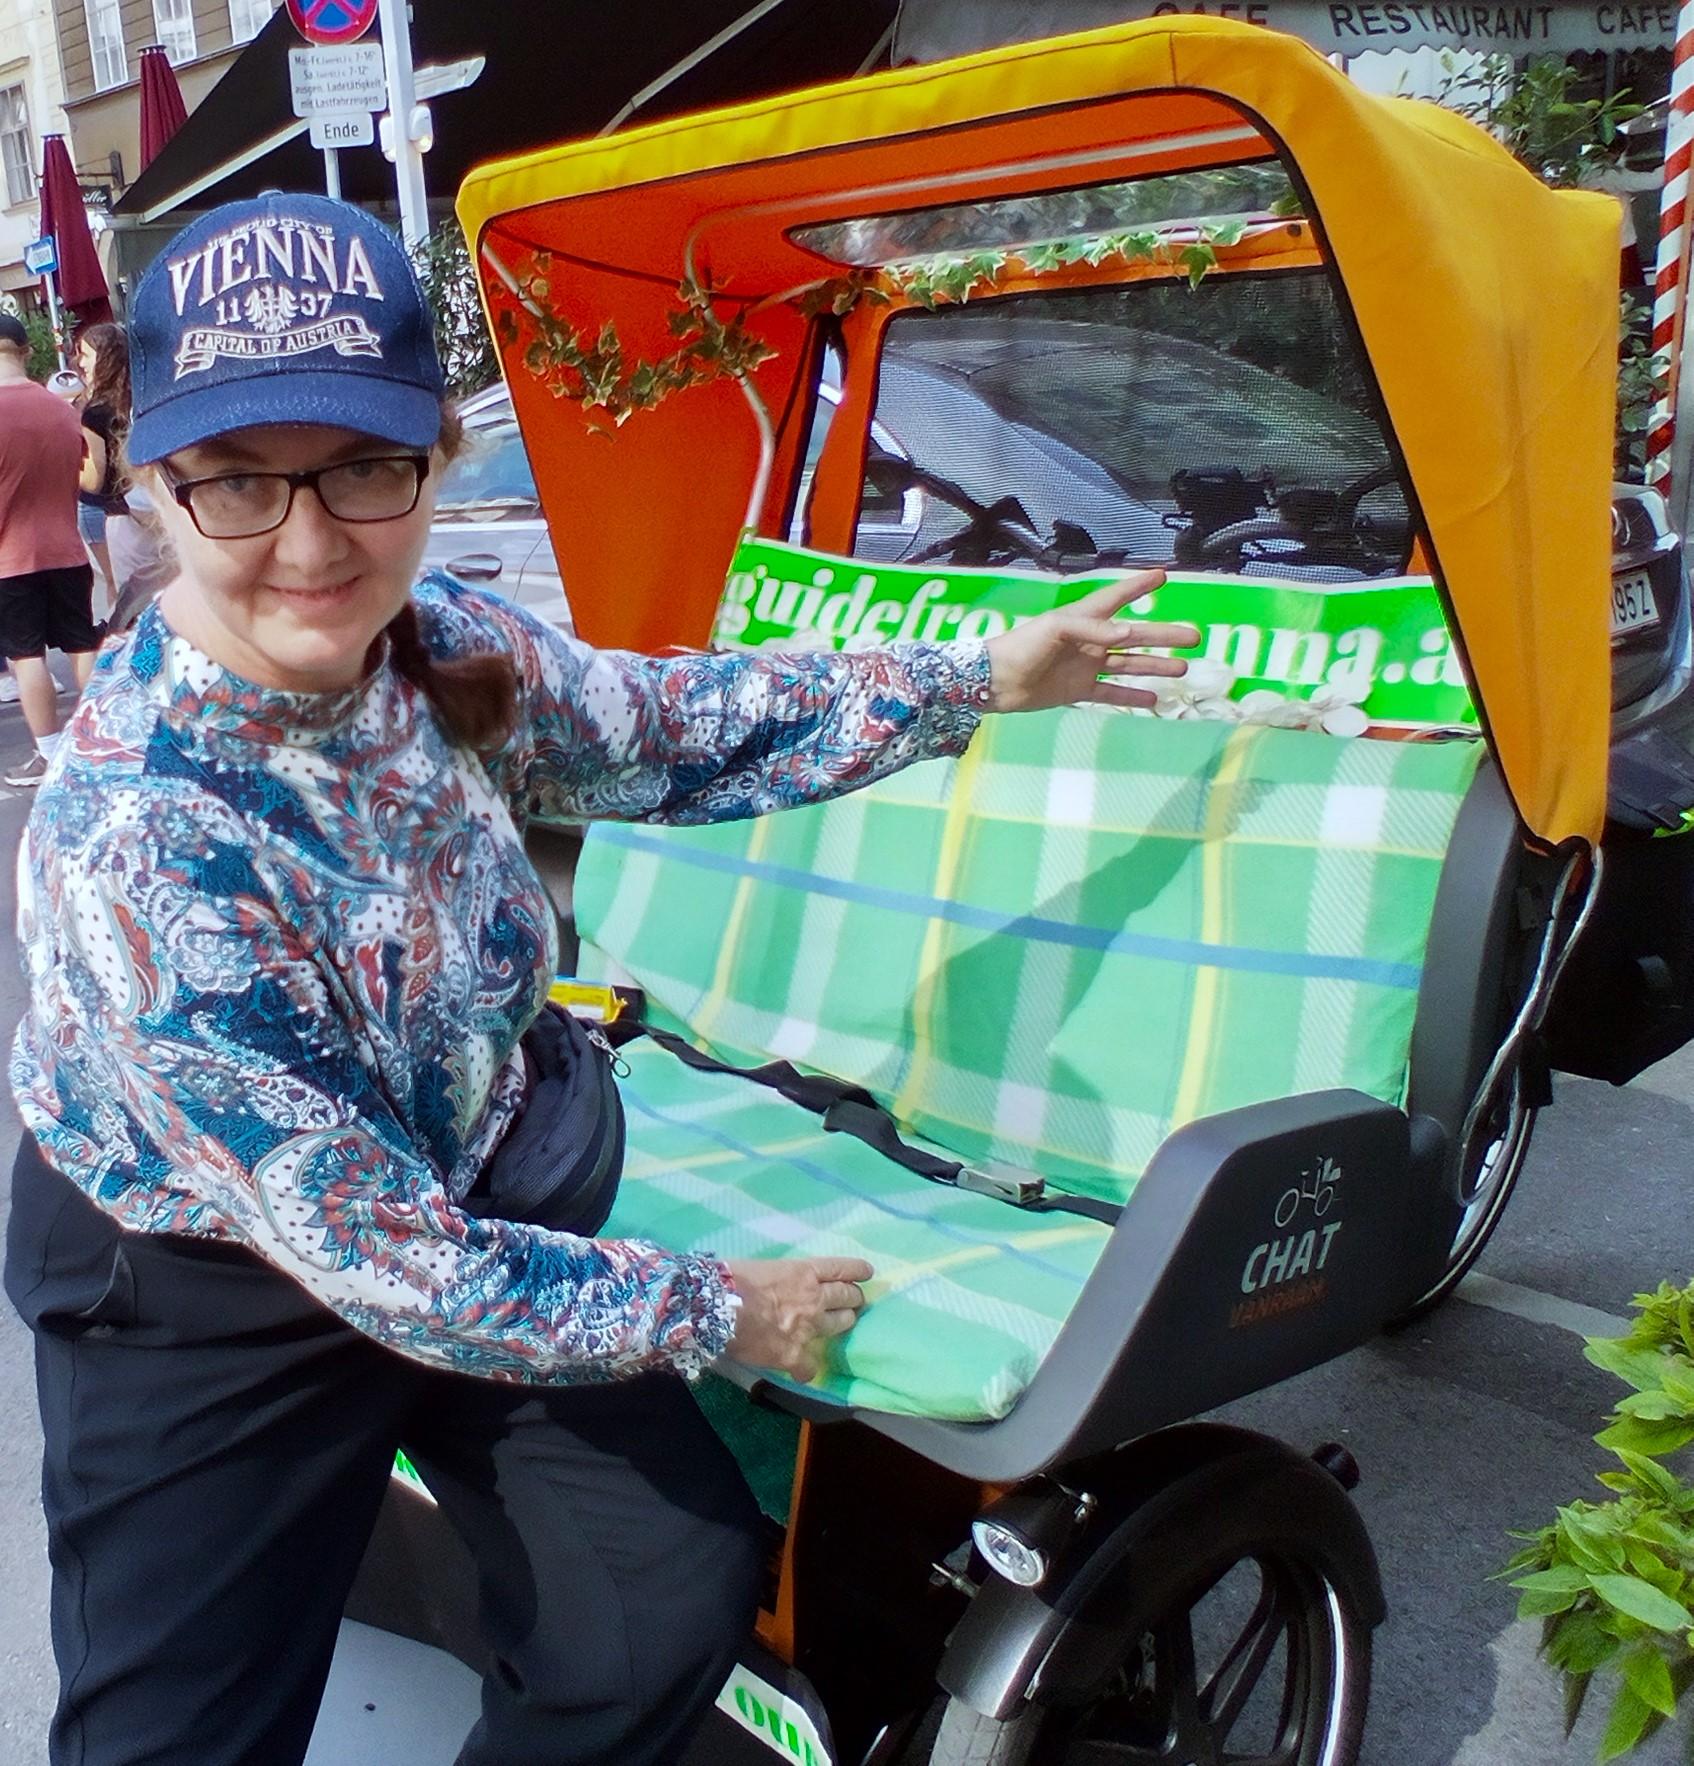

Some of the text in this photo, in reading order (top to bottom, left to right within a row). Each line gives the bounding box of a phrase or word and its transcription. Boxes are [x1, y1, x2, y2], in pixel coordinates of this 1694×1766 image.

[1329, 3, 1551, 40] RESTAURANT
[324, 122, 359, 139] Ende
[168, 226, 384, 317] VIENNA
[215, 292, 333, 326] 11 37
[194, 320, 354, 354] CAPITAL OF AUSTRIA
[1241, 1221, 1342, 1294] CHAT
